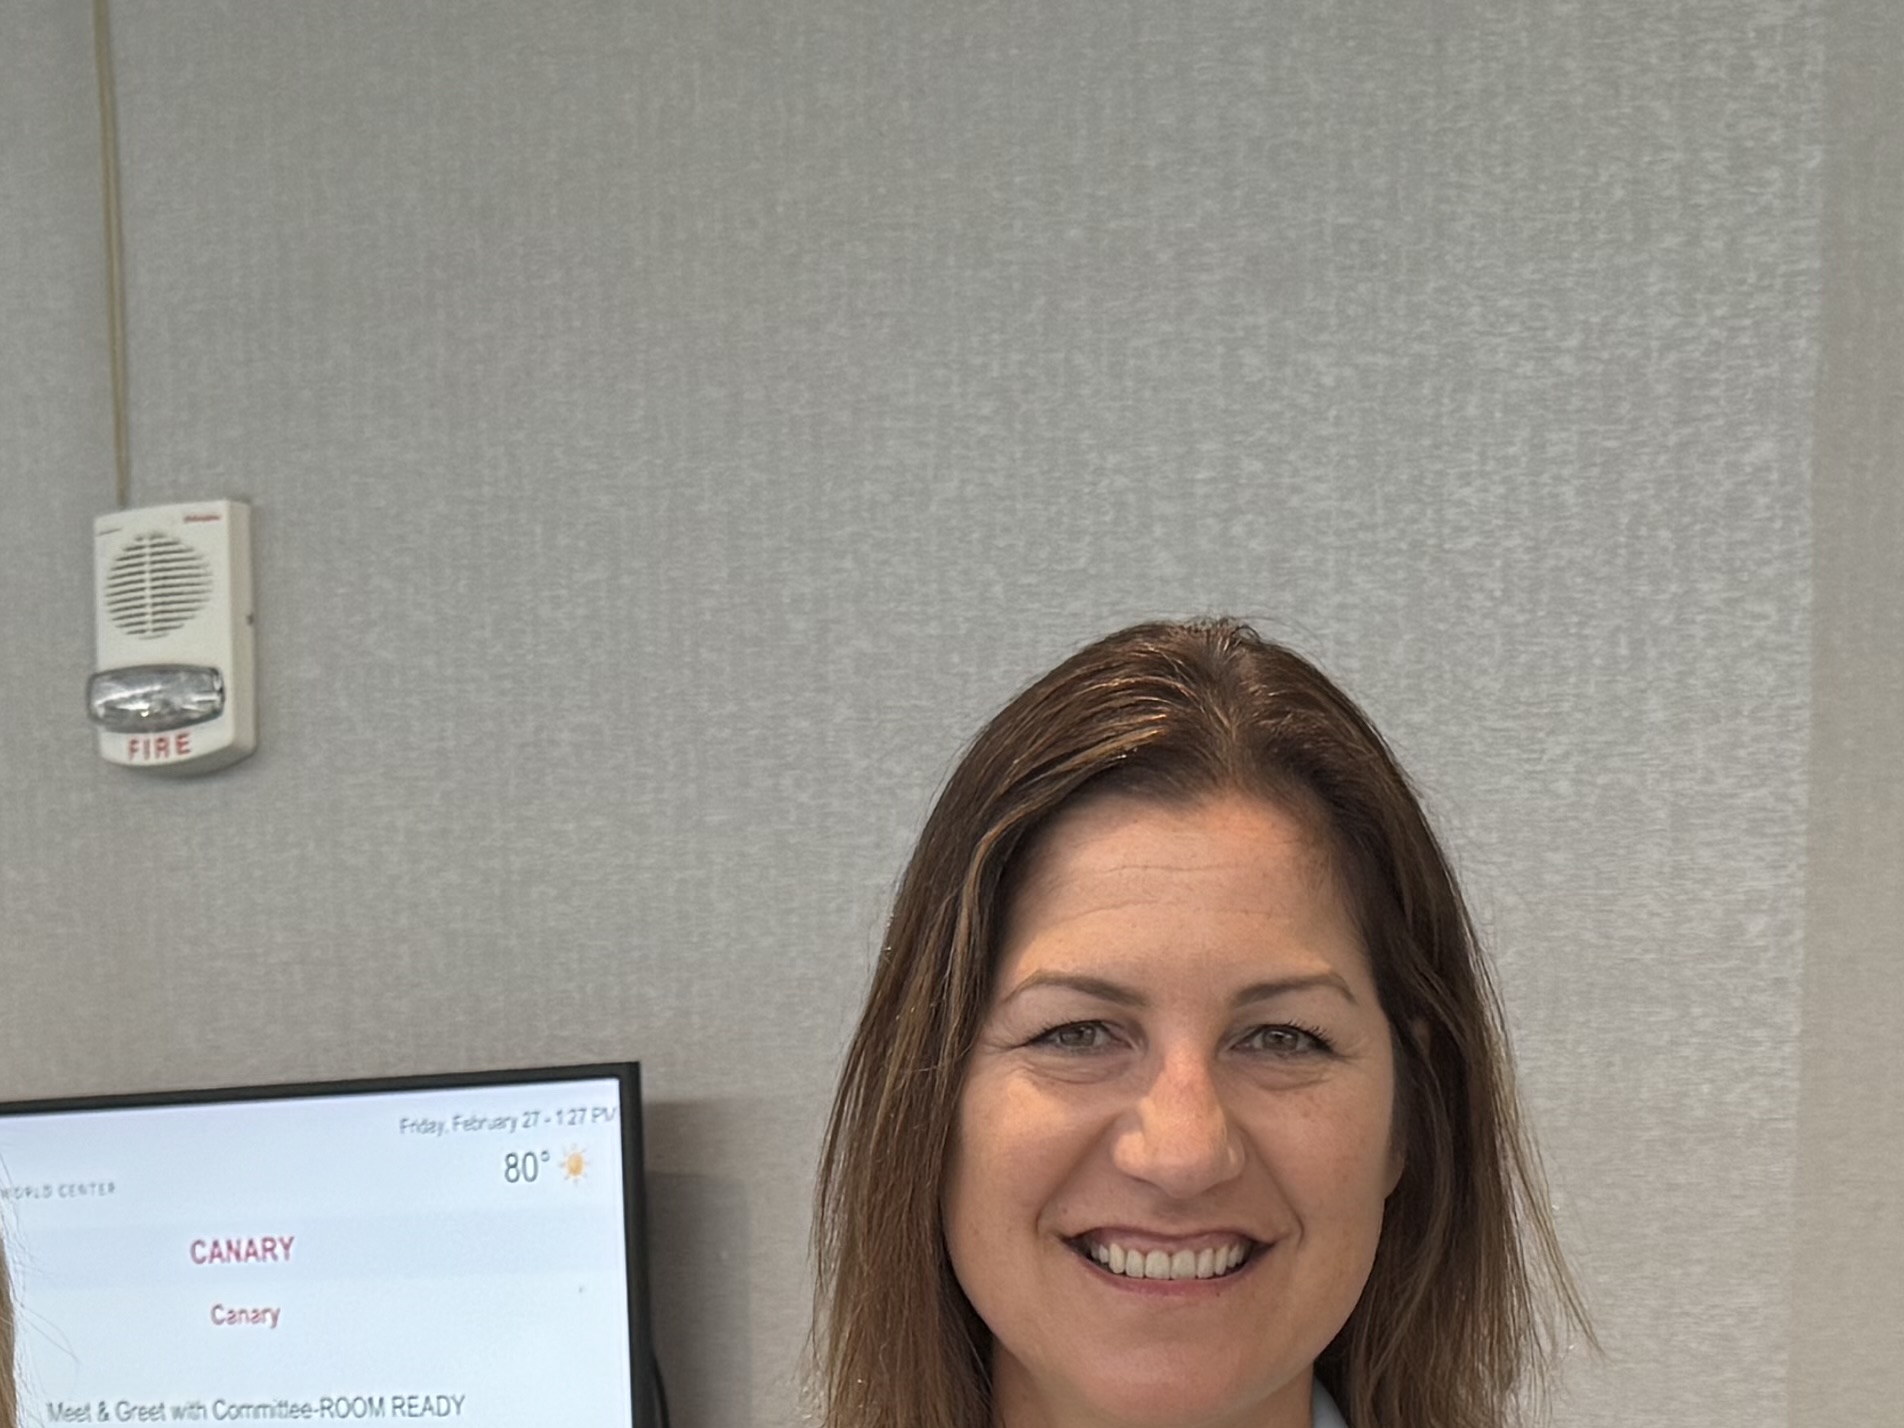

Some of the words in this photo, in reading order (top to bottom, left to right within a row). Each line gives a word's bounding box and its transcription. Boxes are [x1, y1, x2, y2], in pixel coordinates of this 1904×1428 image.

[127, 731, 193, 761] FIRE
[398, 1115, 451, 1137] Friday,
[452, 1113, 518, 1136] February
[522, 1111, 541, 1129] 27
[503, 1149, 550, 1185] 80°
[58, 1182, 116, 1199] CENTER
[189, 1236, 295, 1266] CANARY
[209, 1302, 280, 1329] Canary
[47, 1402, 92, 1423] Meet
[98, 1401, 110, 1422] &
[114, 1400, 167, 1422] Greet
[171, 1399, 208, 1421] with
[212, 1396, 385, 1420] Committee-ROOM
[391, 1395, 466, 1418] READY
